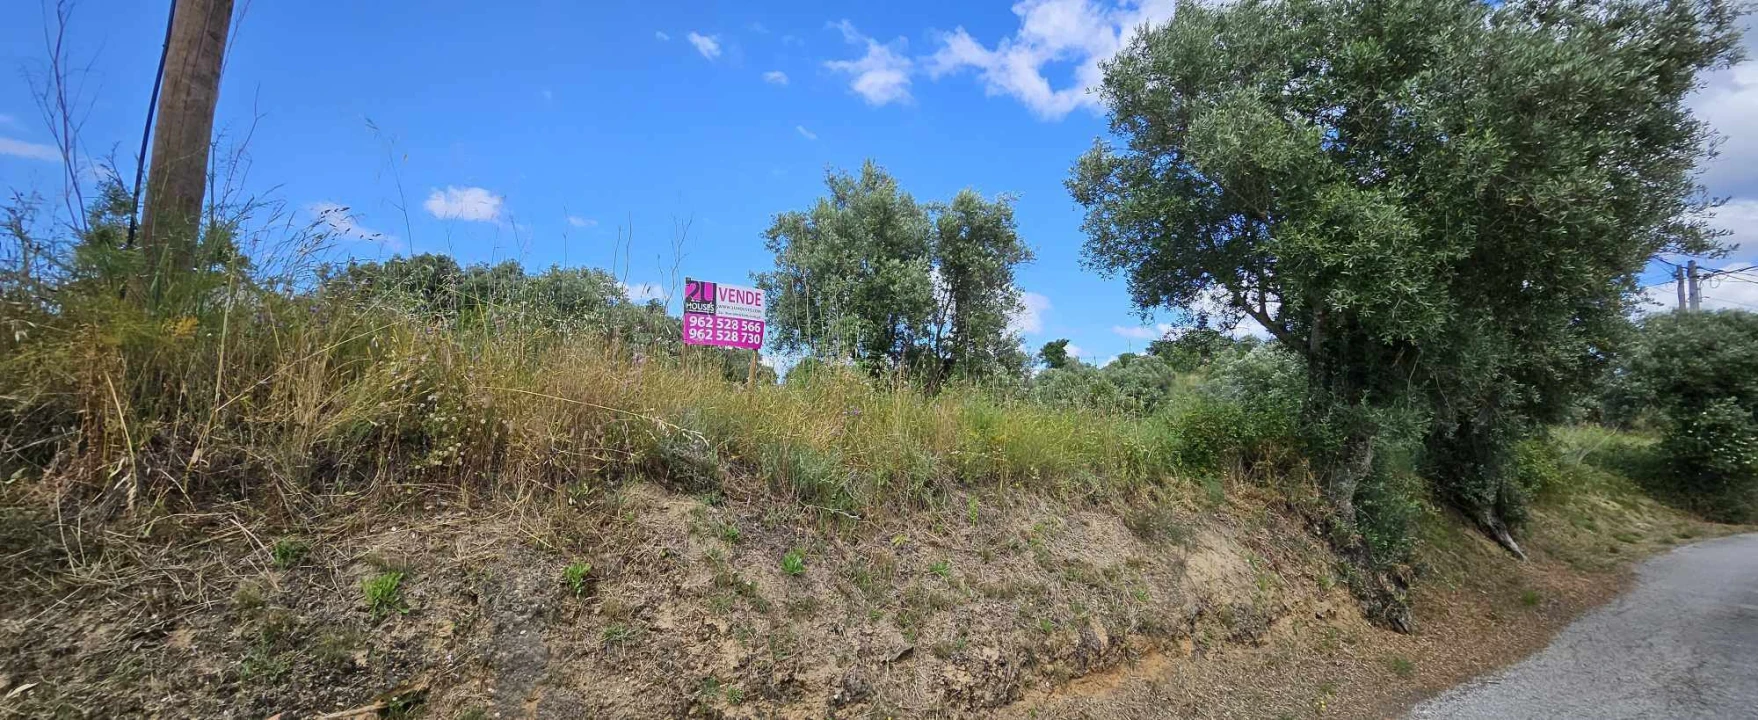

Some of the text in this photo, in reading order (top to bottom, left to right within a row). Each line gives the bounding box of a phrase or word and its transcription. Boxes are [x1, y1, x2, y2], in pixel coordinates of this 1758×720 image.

[718, 287, 762, 307] VENDE
[689, 316, 761, 333] 962 528 566
[688, 328, 760, 344] 962 528 730
